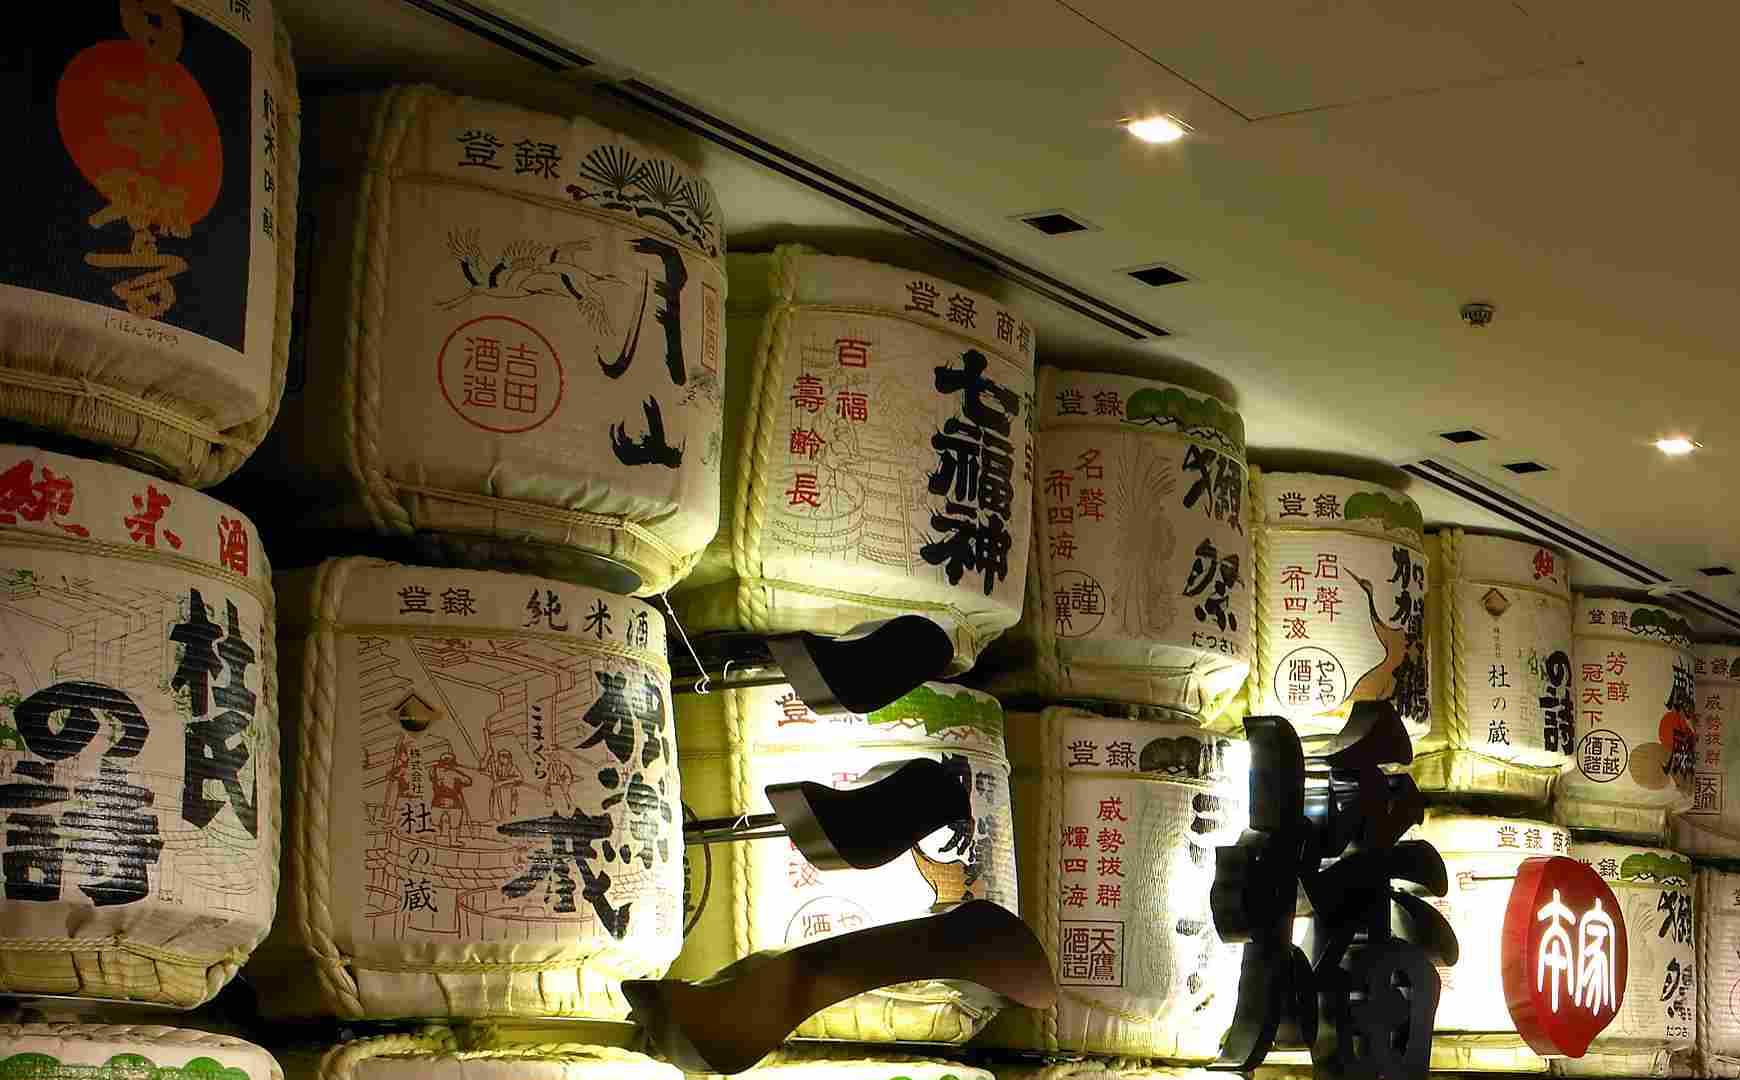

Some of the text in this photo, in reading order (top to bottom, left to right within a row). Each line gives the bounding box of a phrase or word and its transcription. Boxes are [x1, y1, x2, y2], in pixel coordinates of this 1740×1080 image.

[457, 128, 562, 180] 登録
[593, 236, 687, 468] 月山
[836, 336, 870, 426] 百福
[1056, 388, 1124, 416] 登録
[919, 349, 1021, 596] 七福神
[1279, 492, 1341, 518] 登録
[397, 586, 478, 618] 登録
[524, 588, 650, 650] 純米酒
[1488, 664, 1511, 745] 杜の蔵
[530, 705, 548, 780] こまくら
[1067, 740, 1137, 769] 登録
[399, 801, 438, 914] 杜の蔵
